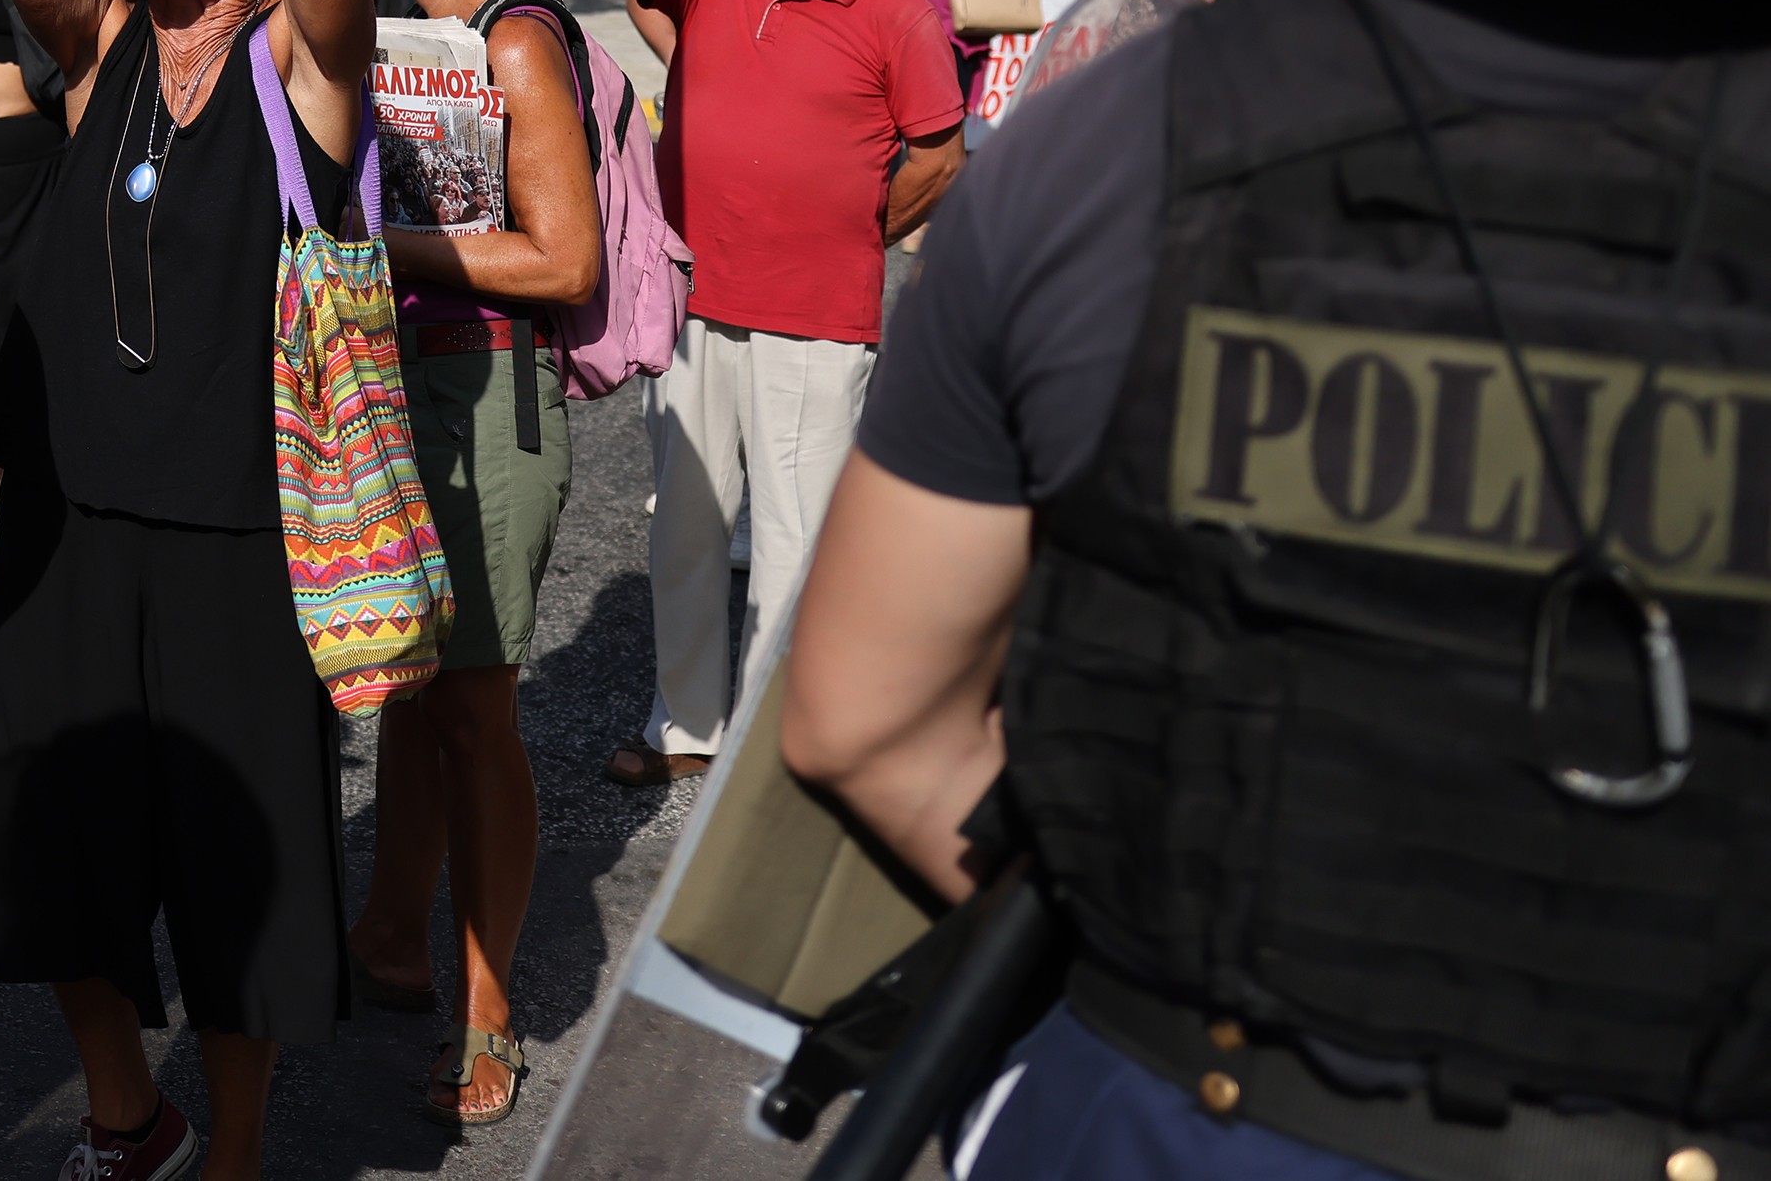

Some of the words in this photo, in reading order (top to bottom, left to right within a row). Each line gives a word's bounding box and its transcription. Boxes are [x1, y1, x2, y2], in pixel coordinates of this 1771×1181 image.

[426, 99, 443, 107] ΑΠΟ
[443, 100, 454, 108] ΤΑ
[454, 100, 473, 108] ΚΑΤΩ
[379, 105, 395, 119] 50
[482, 119, 498, 127] ΑΤΩ
[375, 123, 435, 138] ΤΑΠΟΛΙΤΕΥΣΗ
